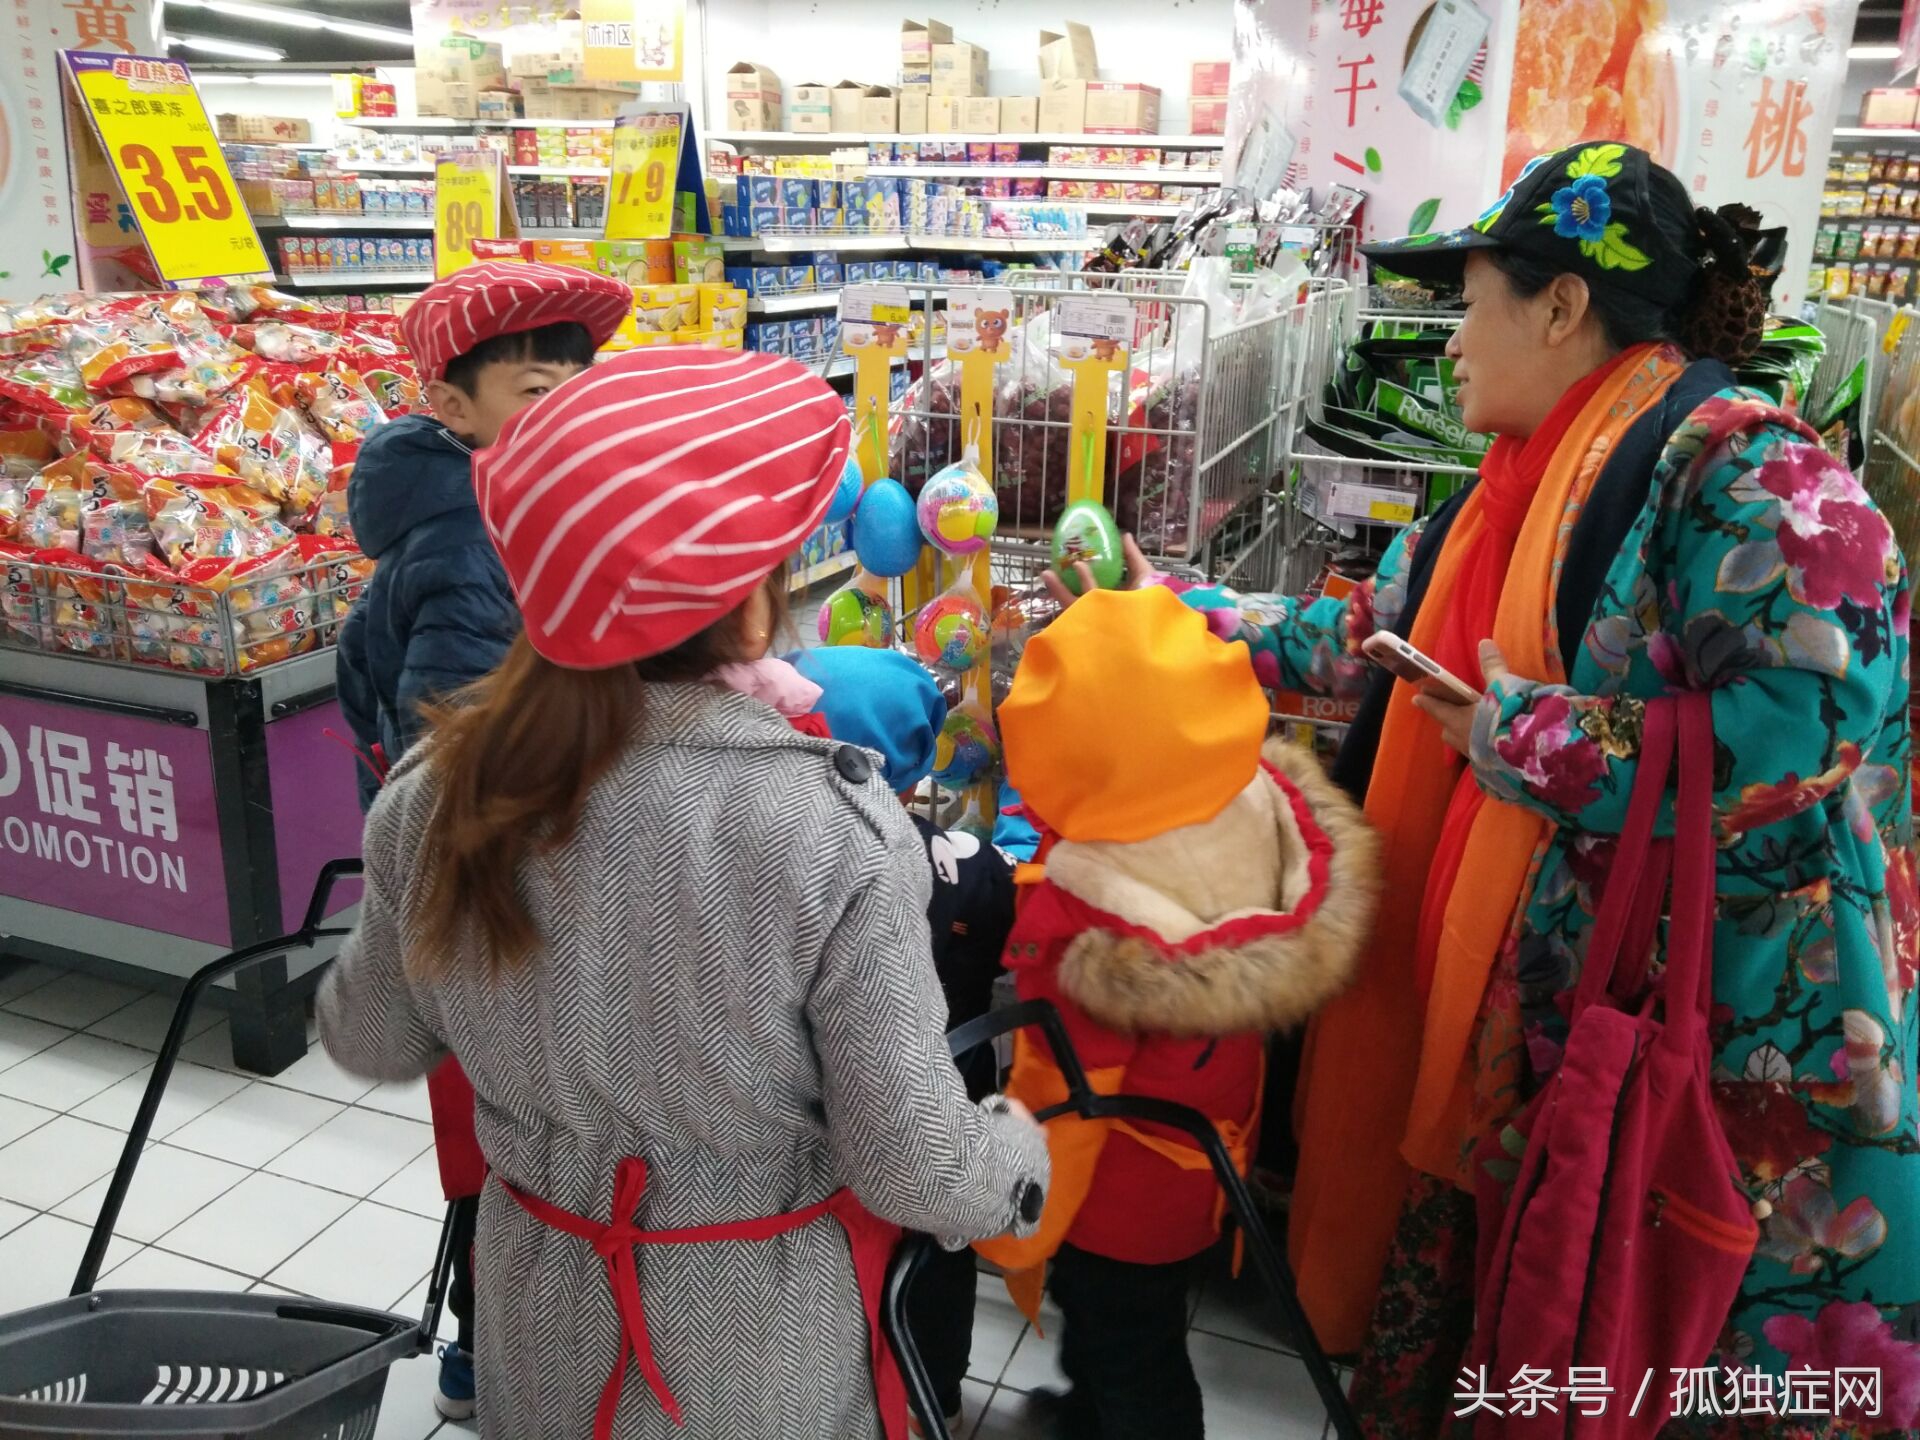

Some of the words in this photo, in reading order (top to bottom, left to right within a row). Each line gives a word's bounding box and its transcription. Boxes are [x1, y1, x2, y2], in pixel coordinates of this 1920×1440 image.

[587, 24, 632, 46] 休闲区
[91, 98, 186, 117] 喜之郎果冻
[1743, 76, 1814, 179] 桃
[119, 143, 233, 224] 3.5
[618, 160, 665, 206] 7.9
[0, 815, 187, 893] OMOTION
